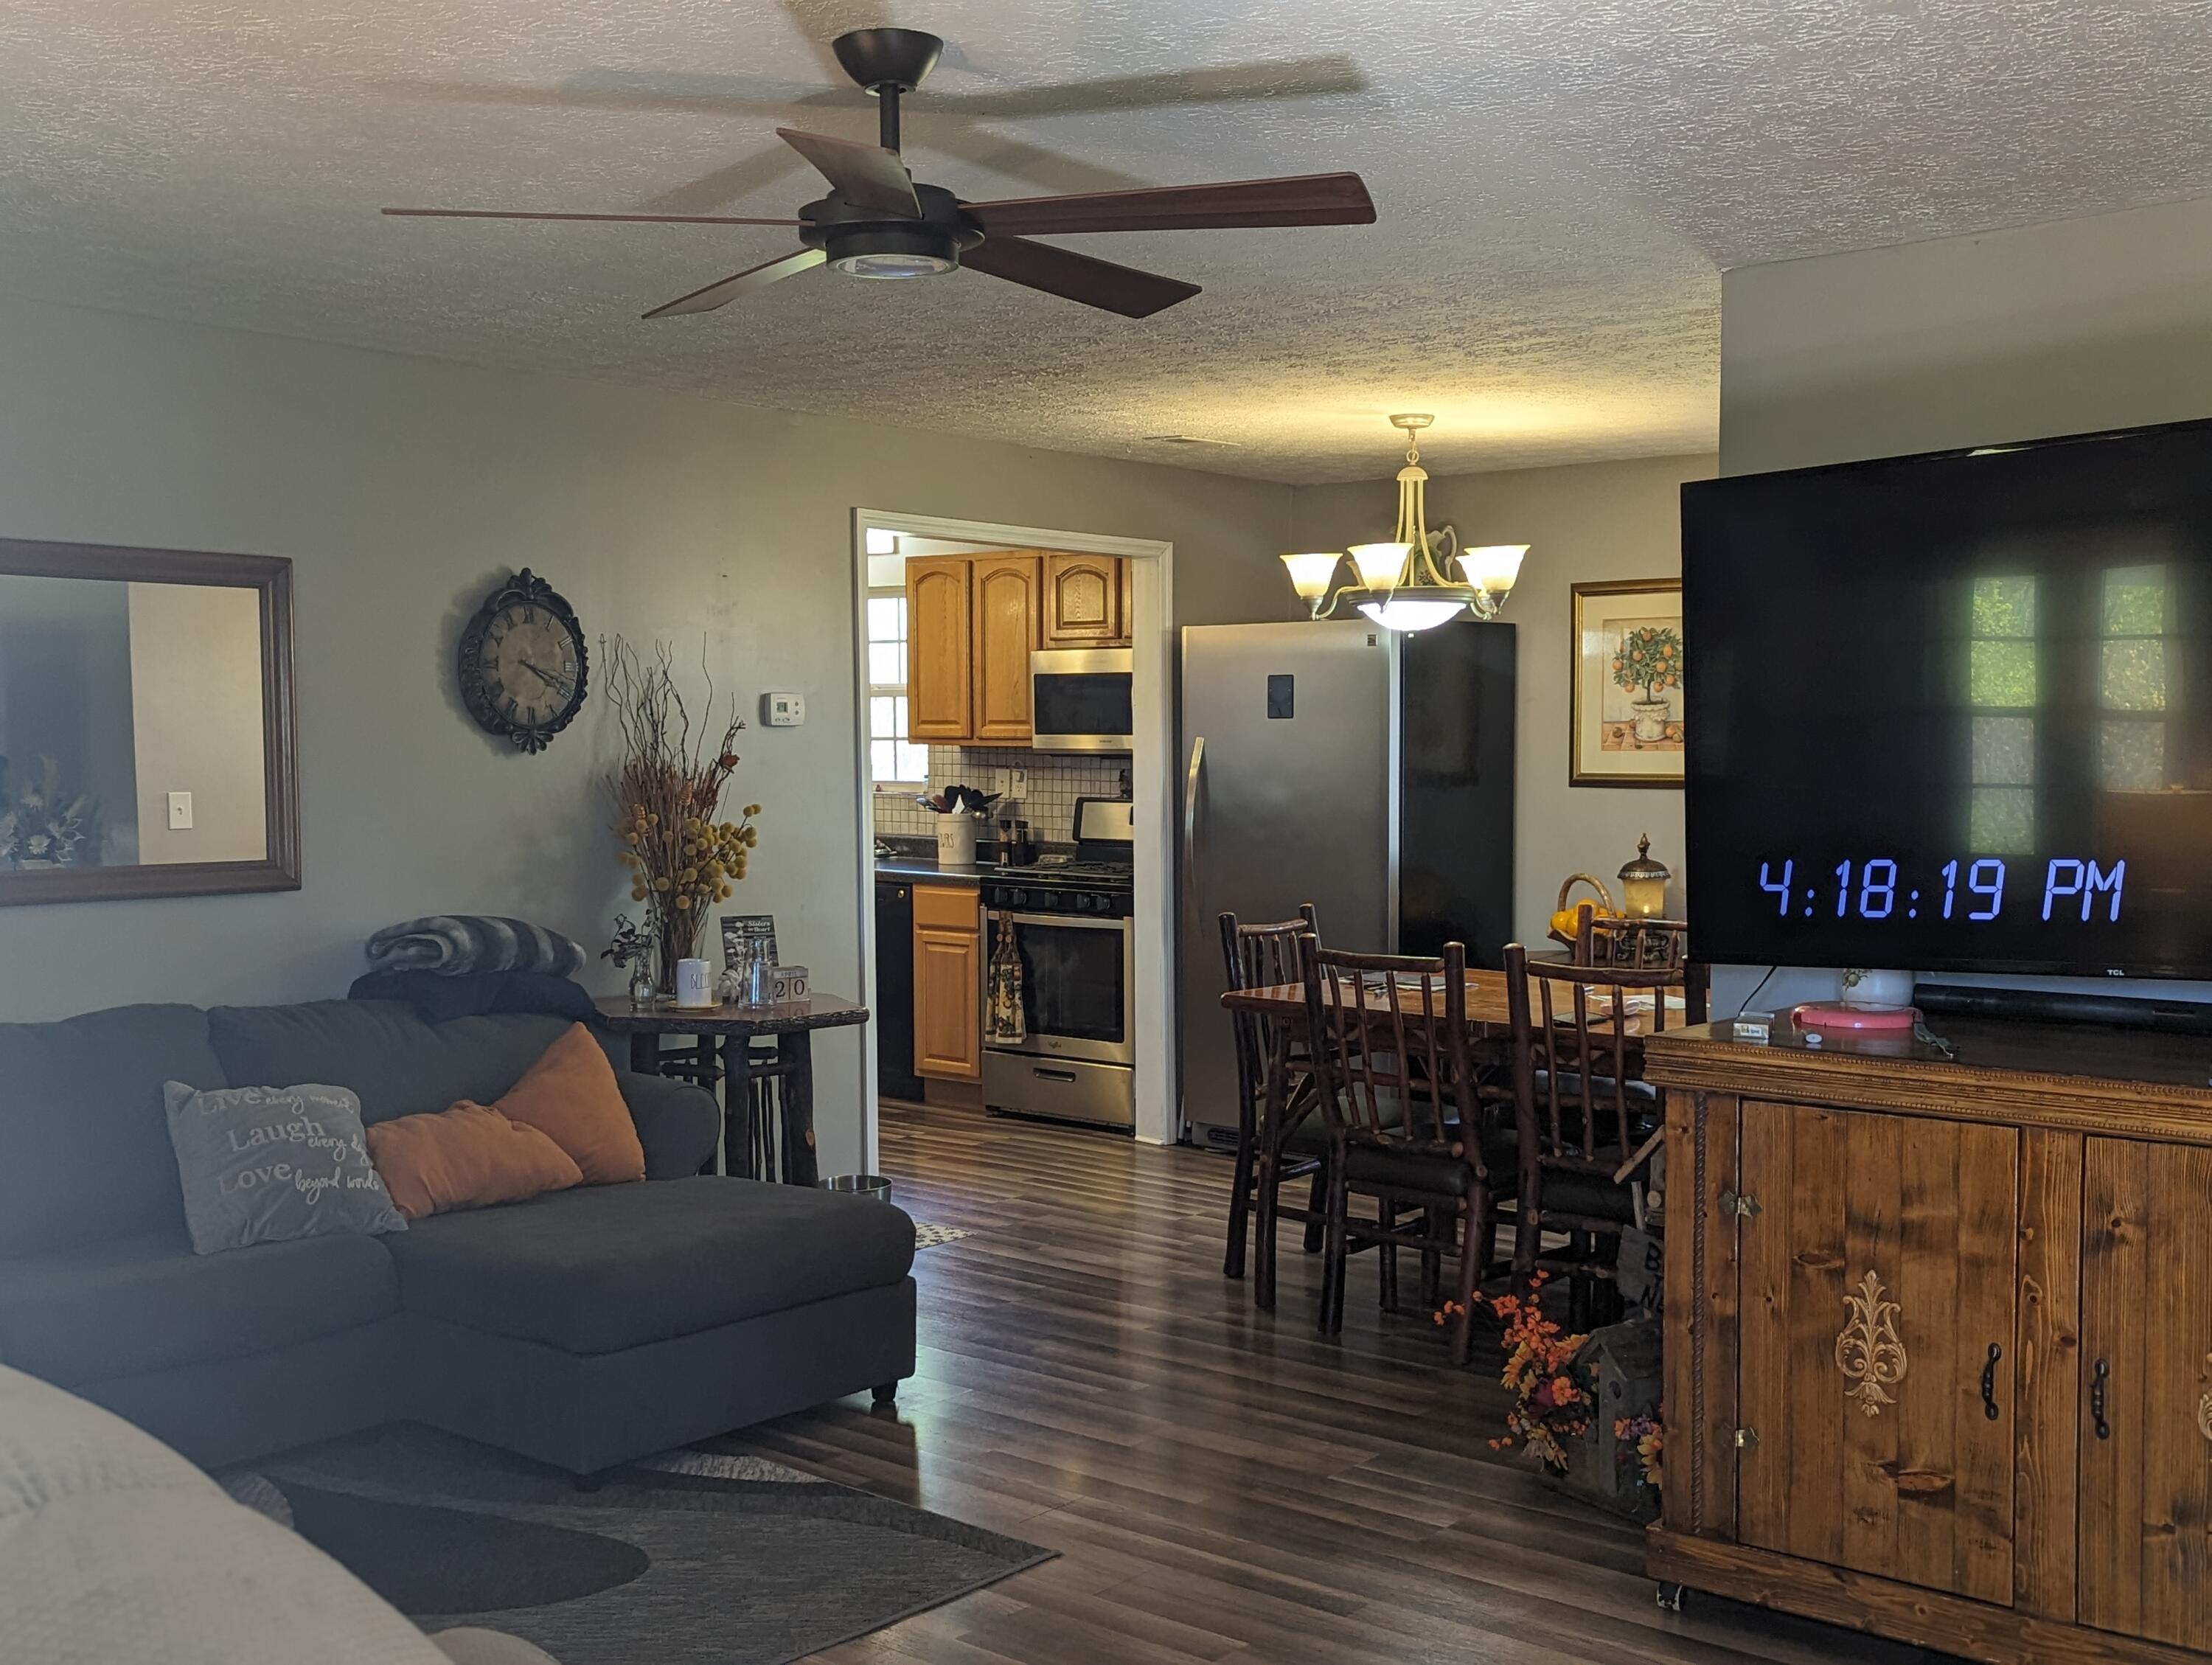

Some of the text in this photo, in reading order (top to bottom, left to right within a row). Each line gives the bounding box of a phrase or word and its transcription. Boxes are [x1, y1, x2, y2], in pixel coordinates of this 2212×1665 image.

[1759, 858, 2126, 922] 4:18:19 PM
[198, 1091, 260, 1115] Live
[227, 1116, 326, 1151] Laugh
[307, 1136, 347, 1161] every
[220, 1163, 380, 1206] Love beyond words
